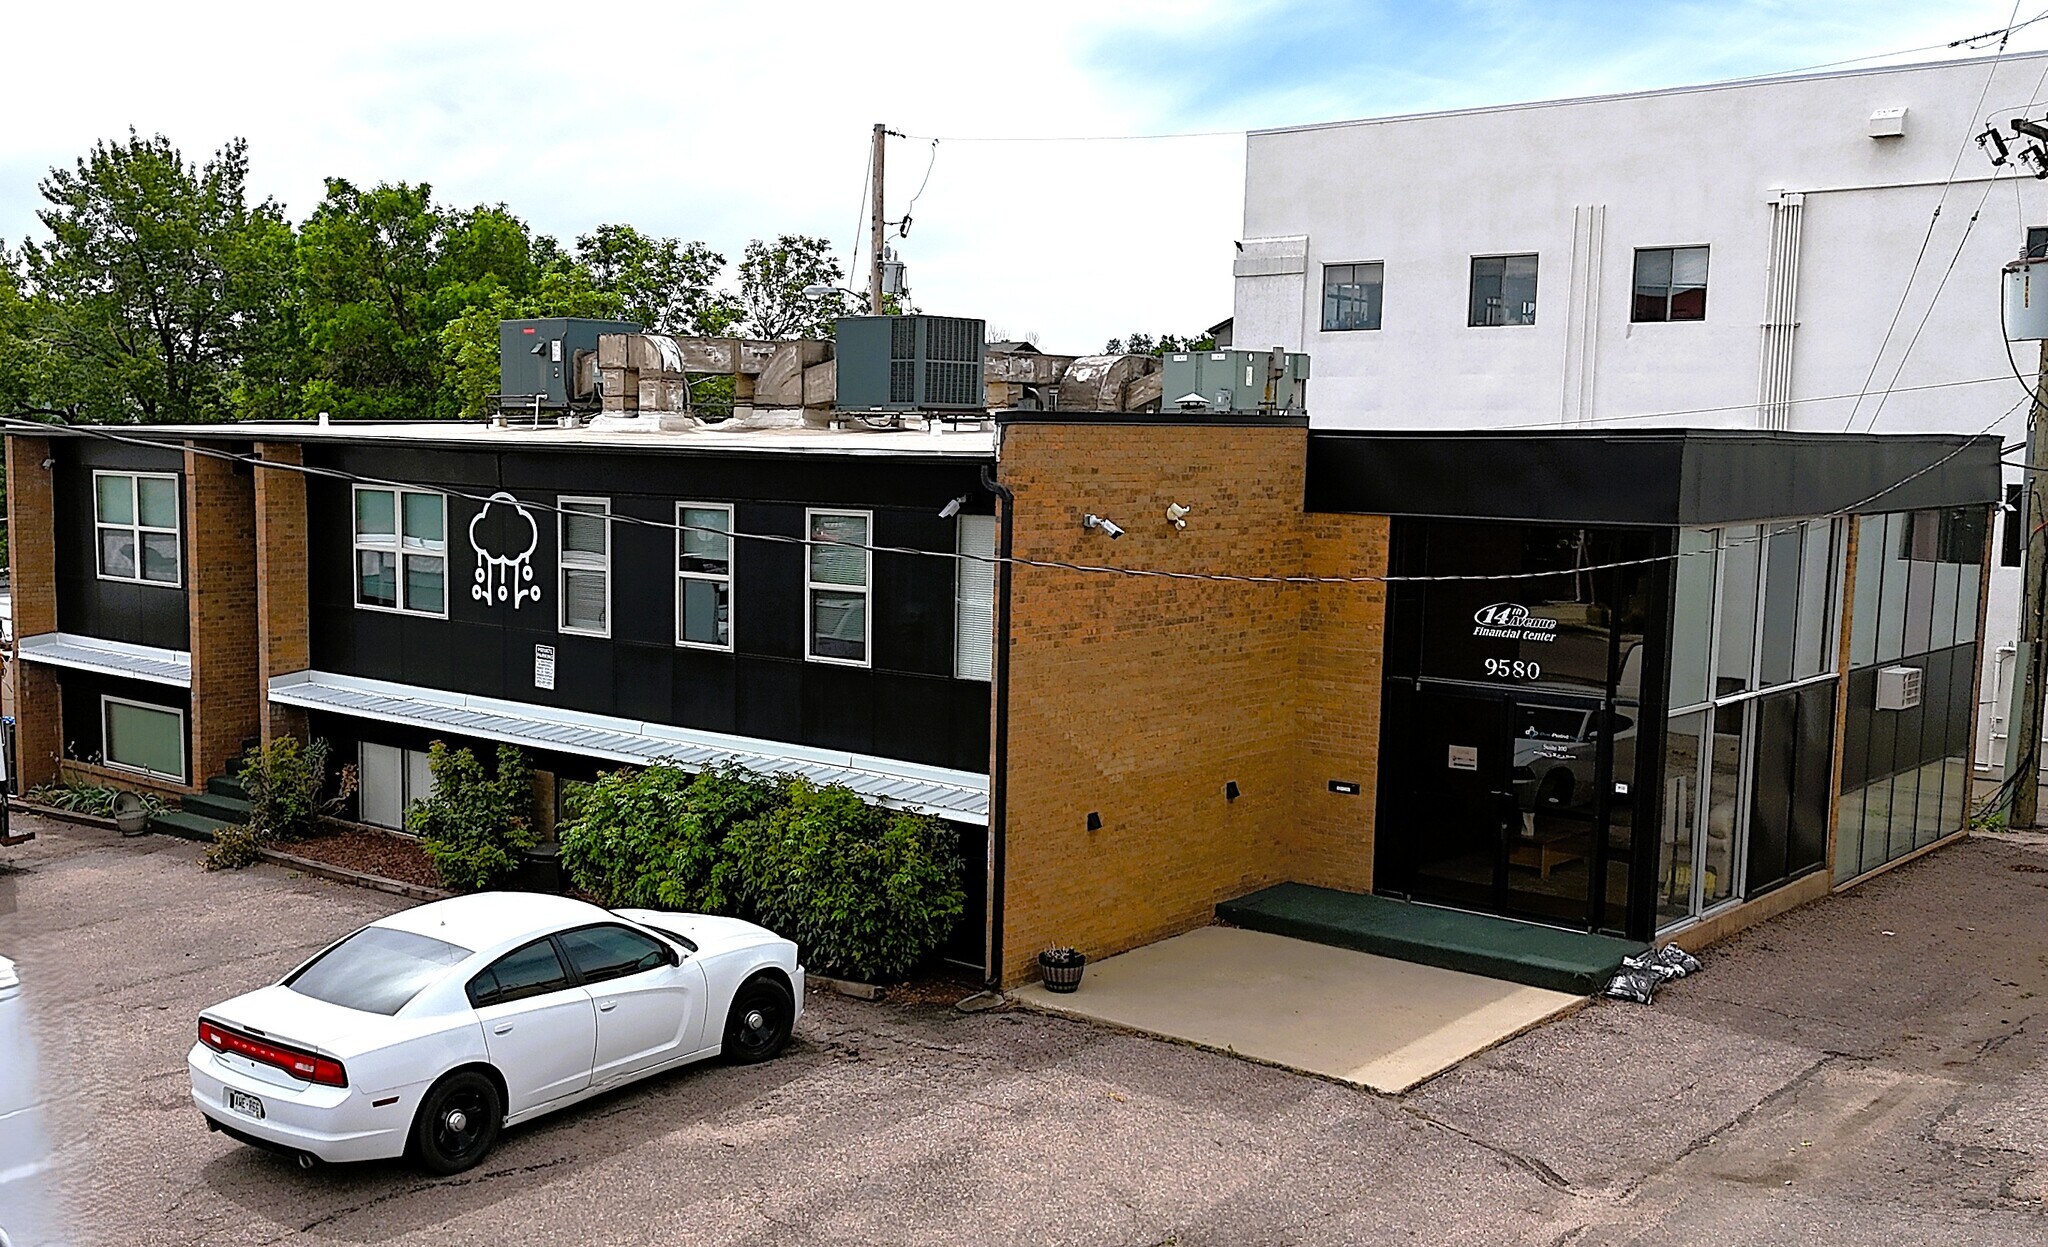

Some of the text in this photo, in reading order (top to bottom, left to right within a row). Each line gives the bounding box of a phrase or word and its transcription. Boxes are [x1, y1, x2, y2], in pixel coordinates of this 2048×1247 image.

[1508, 616, 1556, 629] Avenue
[1473, 627, 1557, 642] Financial Center
[1484, 658, 1540, 679] 9580
